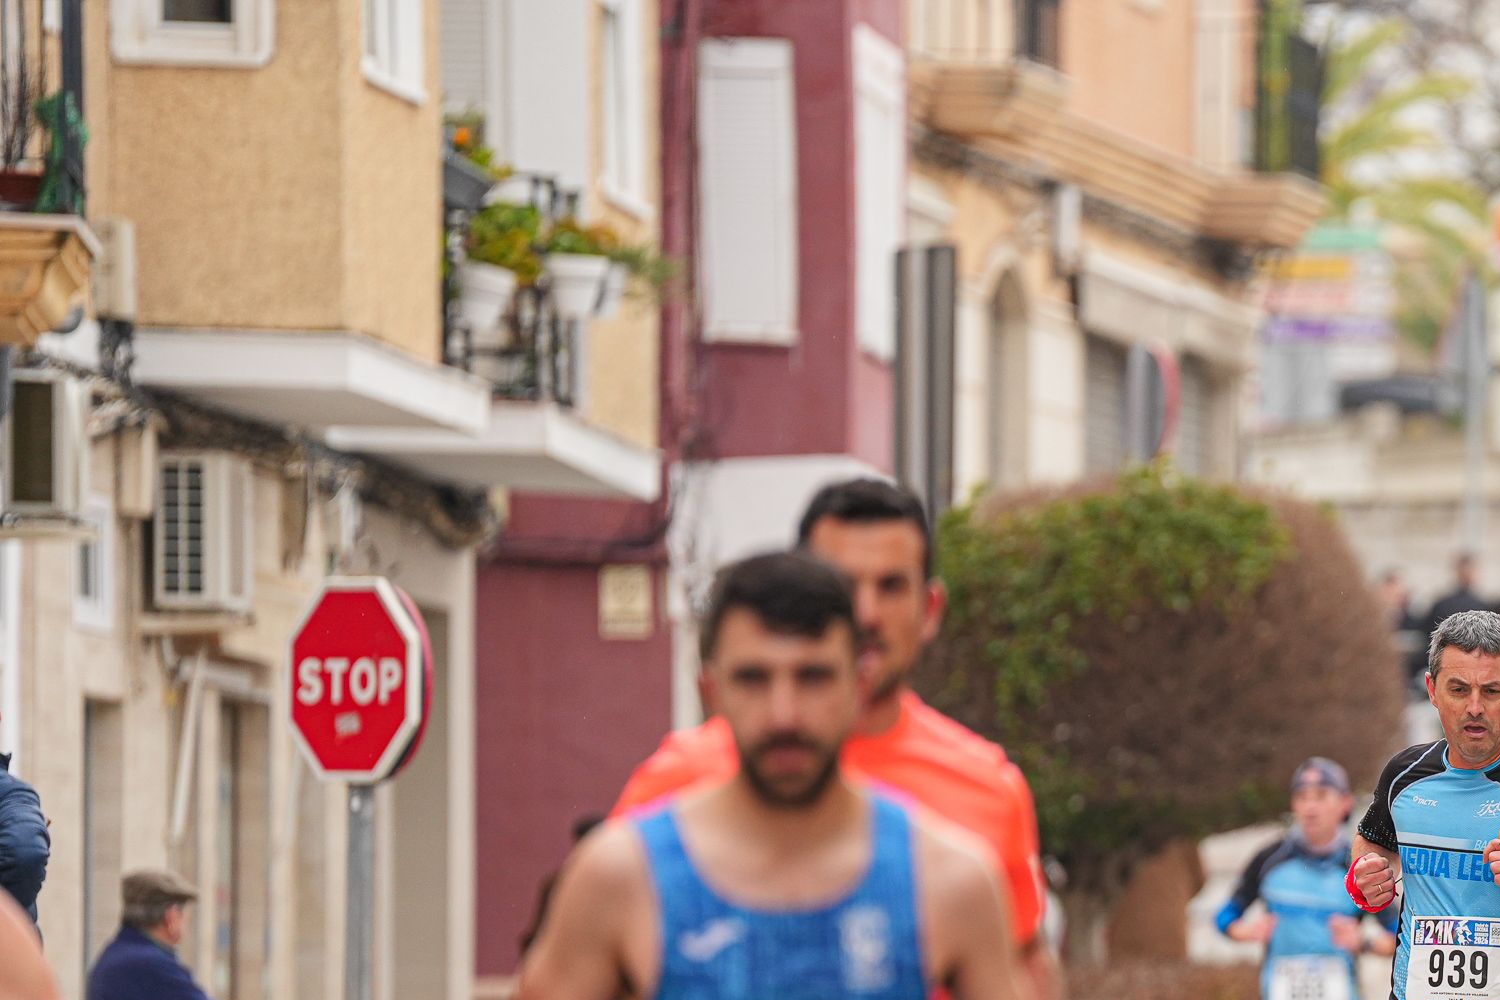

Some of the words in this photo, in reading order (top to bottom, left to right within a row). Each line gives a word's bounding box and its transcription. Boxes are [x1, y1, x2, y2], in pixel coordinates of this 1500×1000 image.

[297, 656, 403, 706] STOP
[1424, 920, 1454, 945] 21K
[1428, 949, 1489, 989] 939
